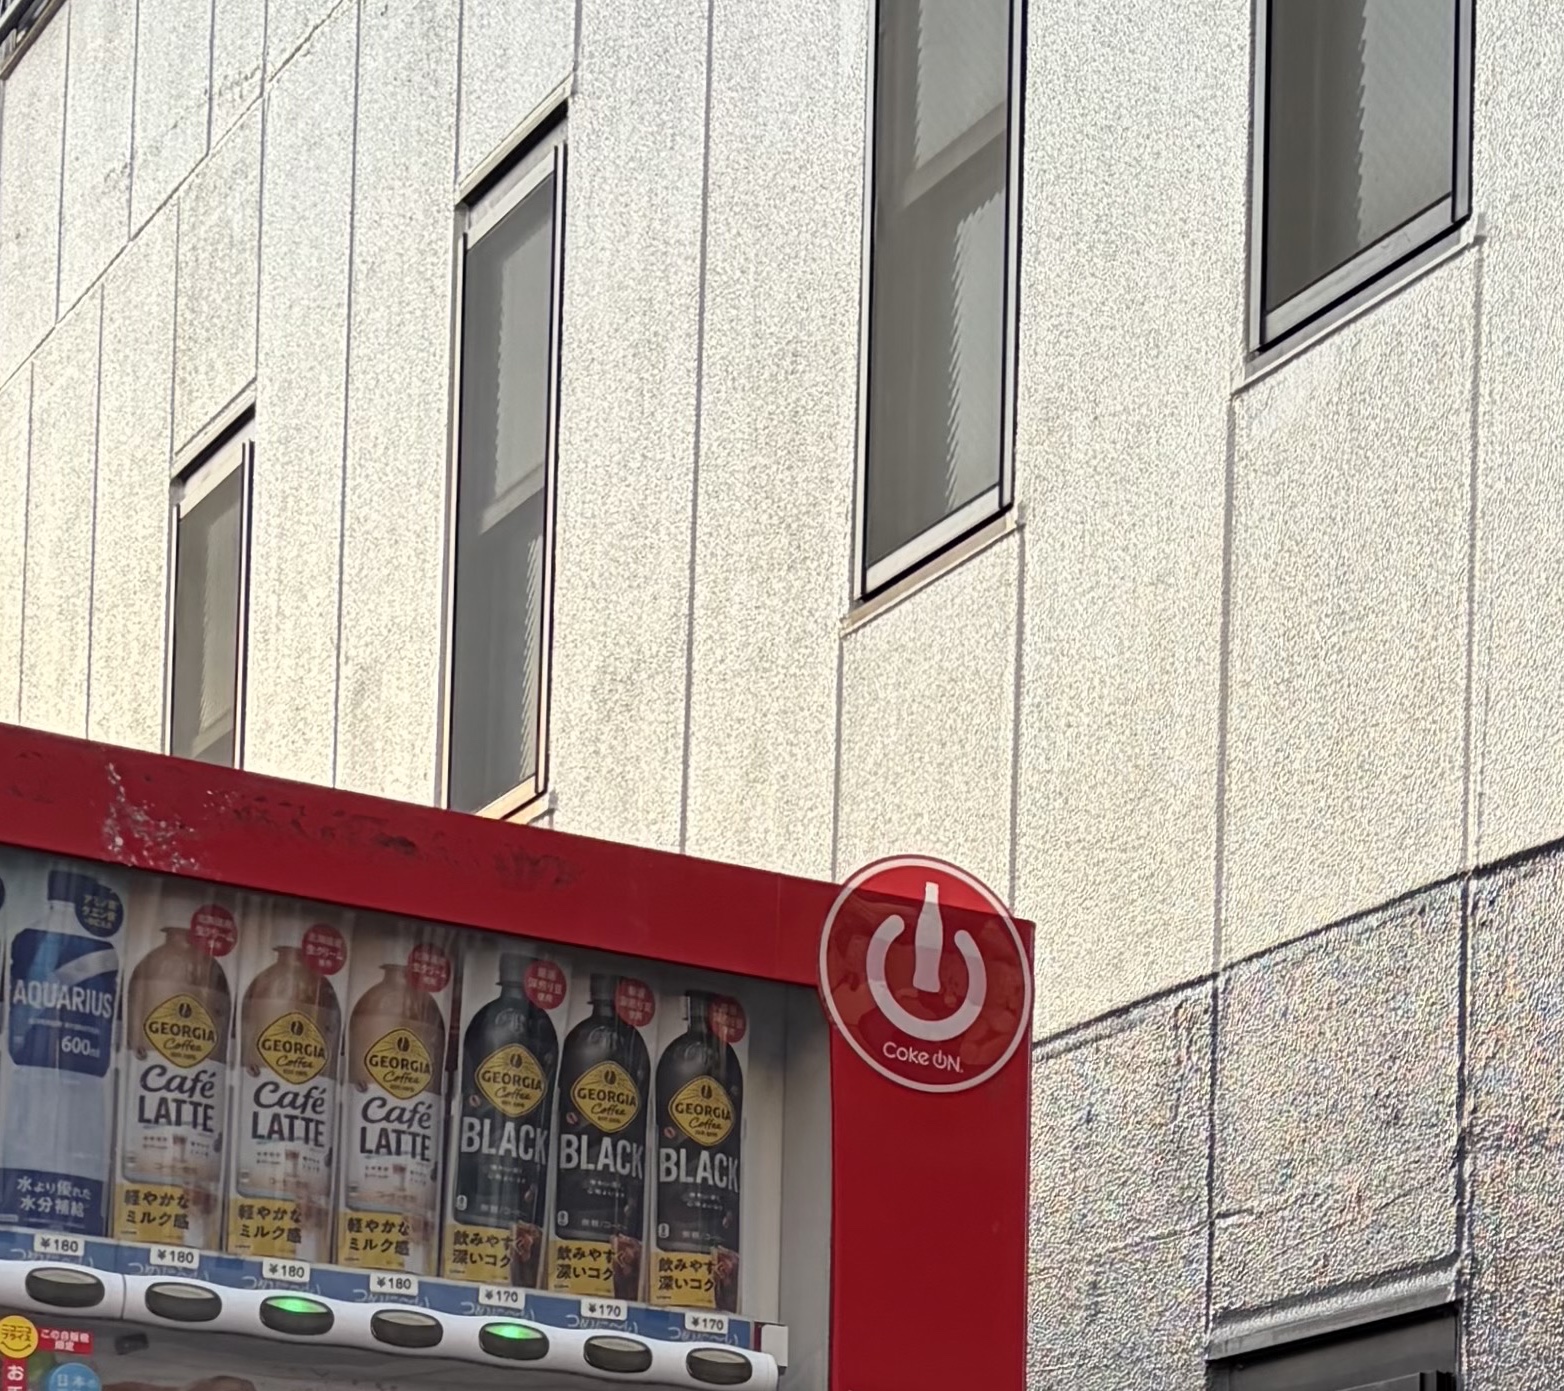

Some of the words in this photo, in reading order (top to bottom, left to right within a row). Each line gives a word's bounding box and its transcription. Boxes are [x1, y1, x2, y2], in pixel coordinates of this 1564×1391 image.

[13, 979, 113, 1019] AQUARIUS
[147, 1020, 217, 1044] GEORGIA
[261, 1038, 327, 1059] GEORGIA
[882, 1040, 930, 1067] Coke
[932, 1049, 962, 1074] ON
[368, 1053, 431, 1075] GEORGIA
[139, 1064, 216, 1099] Café
[480, 1069, 545, 1092] GEORGIA
[253, 1081, 327, 1116] Café
[575, 1086, 640, 1108] GEORGIA
[138, 1095, 215, 1133] LATTE
[361, 1096, 433, 1130] Café
[674, 1101, 734, 1122] GEORGIA
[251, 1111, 326, 1148] LATTE
[359, 1126, 432, 1163] LATTE
[460, 1116, 549, 1167] BLACK
[560, 1133, 646, 1181] BLACK
[659, 1148, 741, 1194] BLACK
[17, 1176, 92, 1199] 水より優れた
[20, 1198, 85, 1219] 水分補給
[39, 1237, 79, 1252] ¥180
[157, 1249, 195, 1264] ¥180
[452, 1249, 512, 1268] 深いコク
[268, 1263, 306, 1278] ¥180
[556, 1264, 614, 1282] 深いコク
[376, 1276, 412, 1291] ¥180
[658, 1275, 716, 1293] 深いコク
[485, 1289, 519, 1303] ¥170
[588, 1302, 622, 1316] ¥170
[1, 1324, 32, 1333] ニコニコ
[691, 1316, 724, 1330] ¥170
[1, 1332, 32, 1343] プライス
[40, 1329, 91, 1343] この自販機
